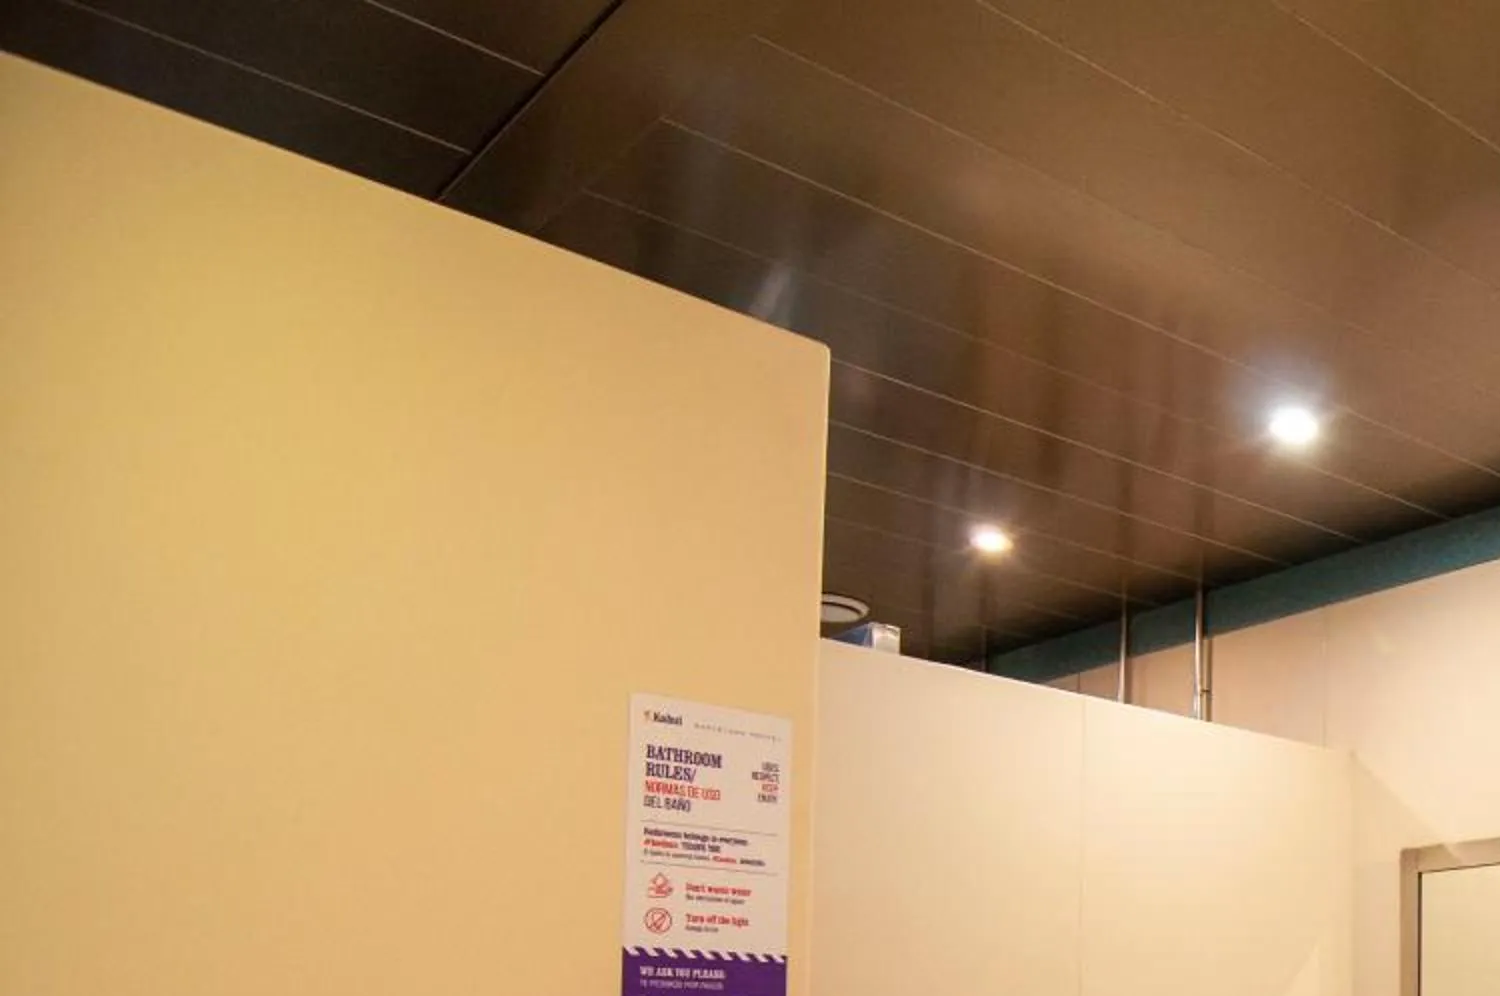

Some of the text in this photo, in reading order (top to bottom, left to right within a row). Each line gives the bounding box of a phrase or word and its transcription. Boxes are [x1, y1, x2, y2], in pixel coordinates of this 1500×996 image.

[646, 744, 723, 769] BATHROOM
[645, 761, 697, 783] RULES/
[645, 780, 721, 801] NORMAS DE USO
[643, 794, 691, 813] DEL BAÑO
[685, 913, 704, 924] Turn
[706, 914, 718, 925] off
[718, 915, 730, 925] the
[731, 916, 750, 929] light
[640, 966, 654, 976] WE
[655, 967, 674, 977] ASK
[675, 967, 691, 978] YOU
